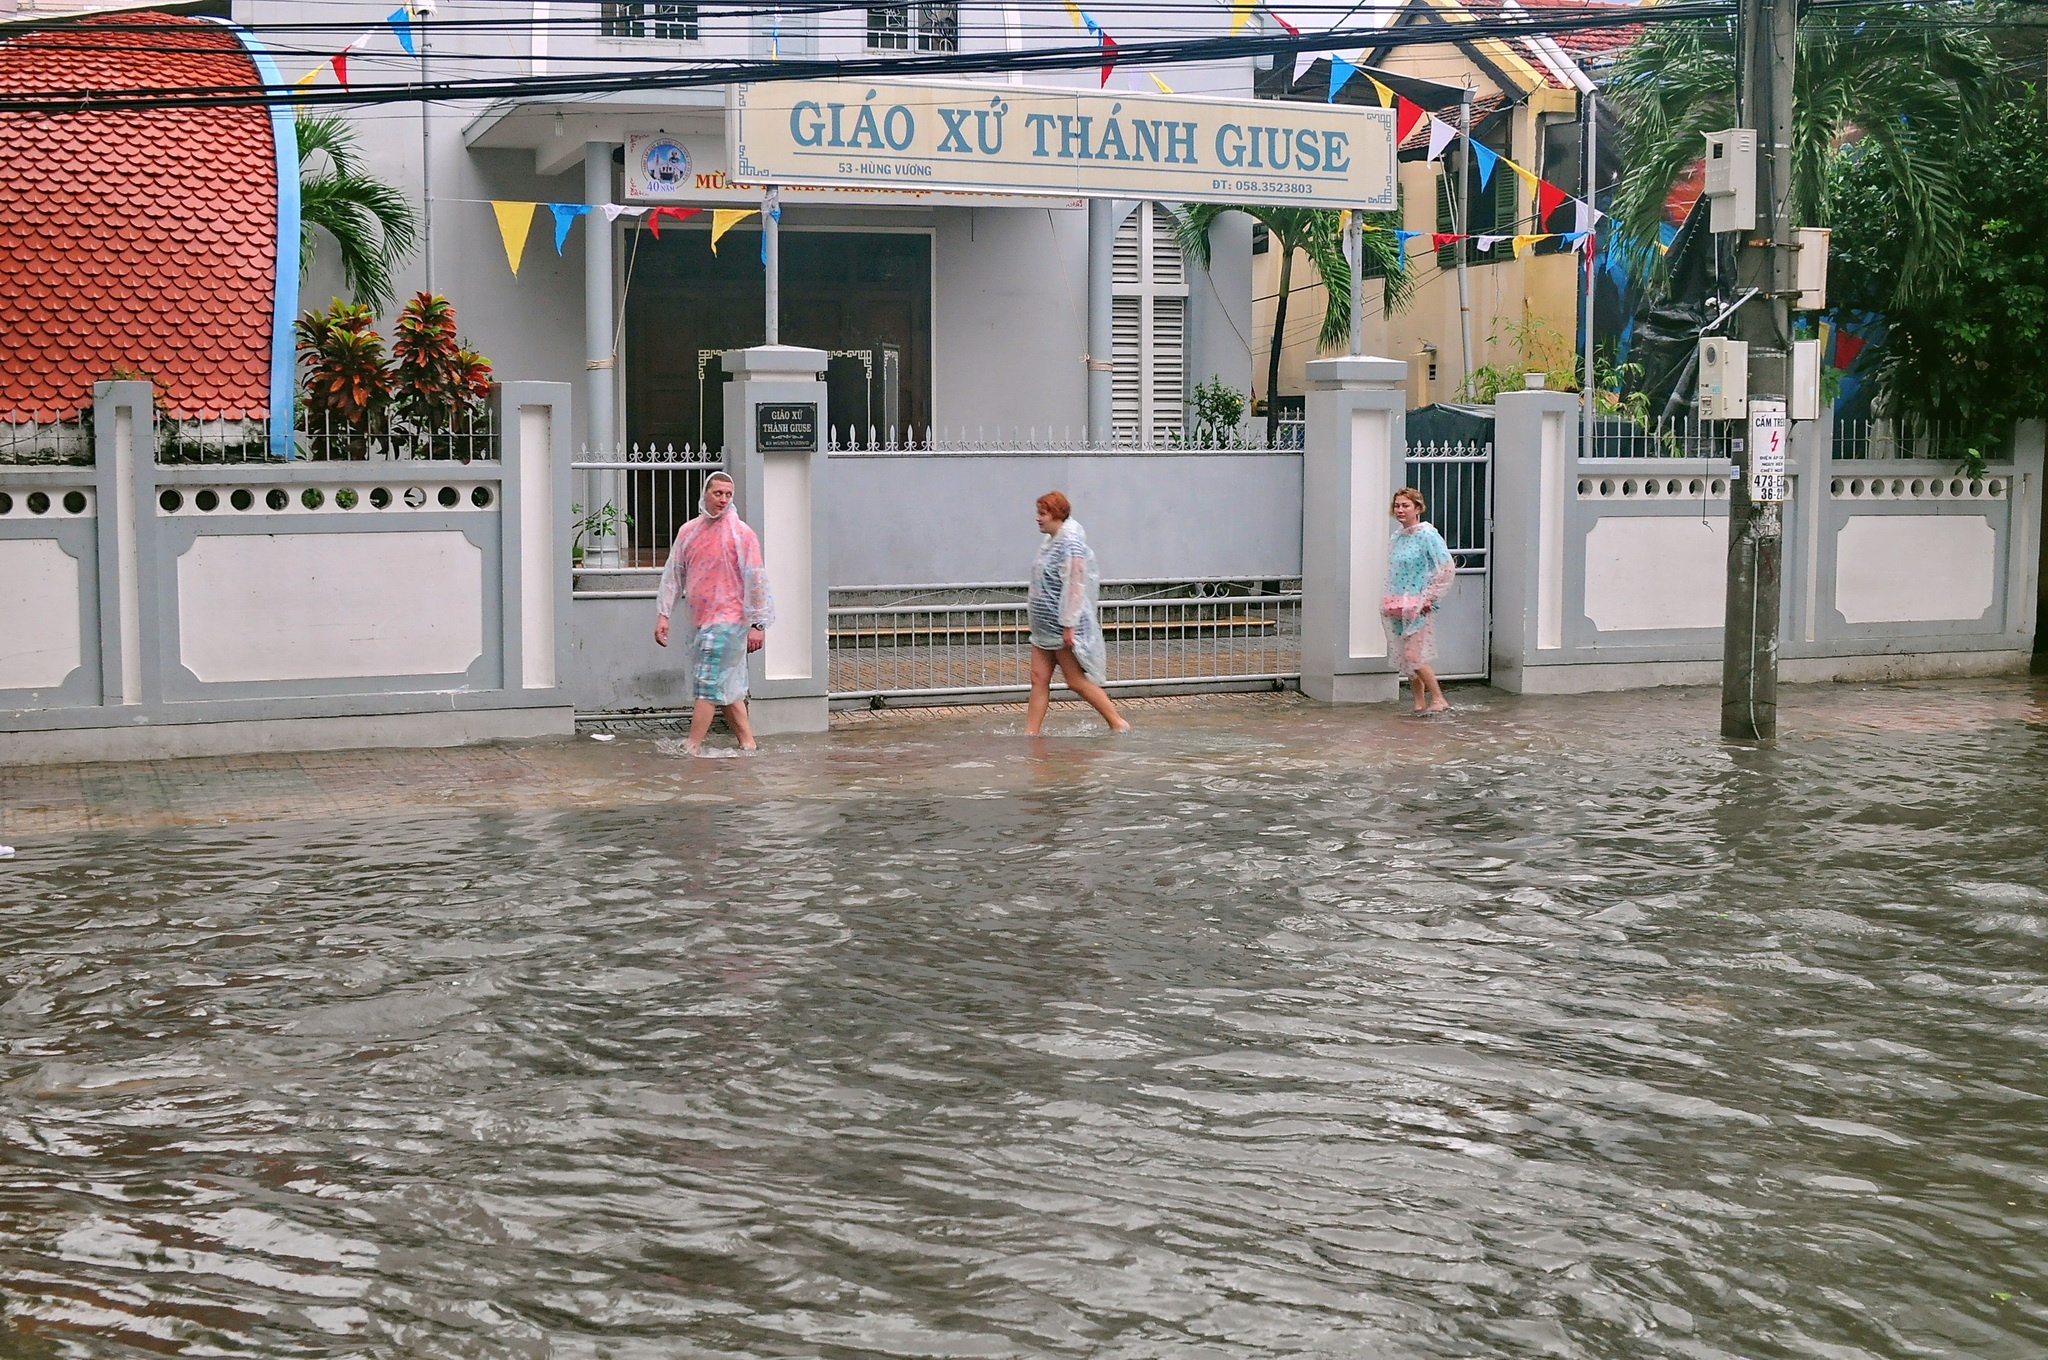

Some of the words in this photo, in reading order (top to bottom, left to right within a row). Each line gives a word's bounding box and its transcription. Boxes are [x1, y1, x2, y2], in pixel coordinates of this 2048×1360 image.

[790, 89, 915, 151] GIÁO
[937, 96, 1008, 155] XỨ
[1025, 103, 1198, 165] THÁNH
[1215, 123, 1351, 172] GIUSE
[838, 162, 853, 174] 53
[895, 163, 932, 176] VƯƠNG
[646, 181, 660, 192] 40
[1212, 179, 1232, 190] ĐT:
[1235, 180, 1313, 194] 058.3523803
[771, 408, 790, 420] GIÁO
[792, 408, 803, 420] XỨ
[1755, 414, 1772, 427] CẤM
[763, 422, 788, 433] THÁNH
[789, 423, 812, 433] GIUSE
